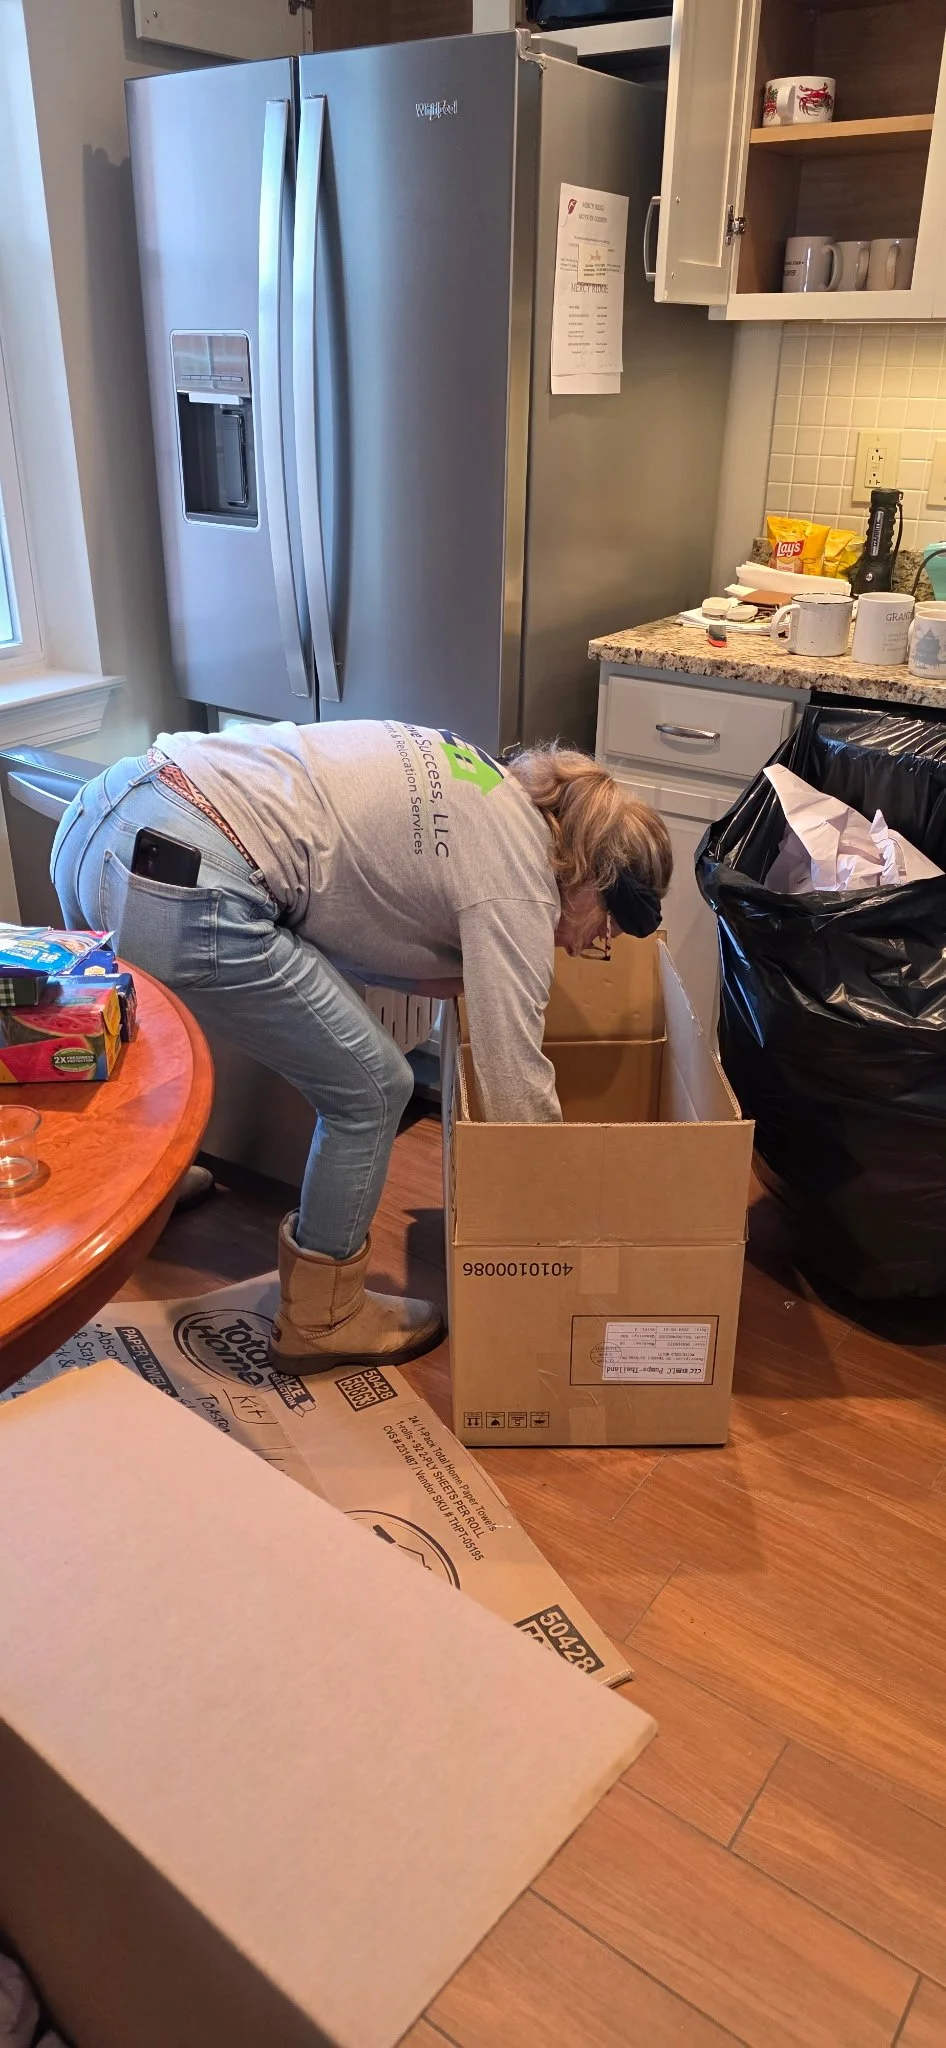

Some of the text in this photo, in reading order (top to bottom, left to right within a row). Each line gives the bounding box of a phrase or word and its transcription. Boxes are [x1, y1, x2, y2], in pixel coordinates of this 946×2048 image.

[396, 740, 417, 792] Relocation
[411, 796, 424, 855] Services
[415, 739, 443, 804] Success,
[433, 813, 449, 857] LLC
[53, 1056, 67, 1064] 2X
[462, 1262, 574, 1276] 4010100086
[122, 1328, 149, 1357] PAPER
[186, 1324, 264, 1386] Home
[270, 1373, 297, 1406] SELECTION
[340, 1377, 377, 1407] 59863
[363, 1370, 394, 1400] 50428
[412, 1443, 425, 1452] 92
[418, 1452, 439, 1471] 2-PLY
[408, 1415, 420, 1424] 24
[417, 1427, 436, 1448] 1-Pack
[433, 1447, 450, 1464] Total
[445, 1463, 463, 1485] Home
[460, 1484, 479, 1506] Paper
[475, 1505, 497, 1532] Towels
[433, 1471, 459, 1501] SHEETS
[383, 1425, 398, 1440] CVS
[395, 1442, 418, 1466] 231487
[415, 1469, 436, 1495] Vendor
[432, 1494, 450, 1512] SKU
[448, 1516, 485, 1561] THPT-05195
[453, 1500, 470, 1517] PER
[465, 1516, 486, 1539] ROLL
[540, 1611, 596, 1673] 50428
